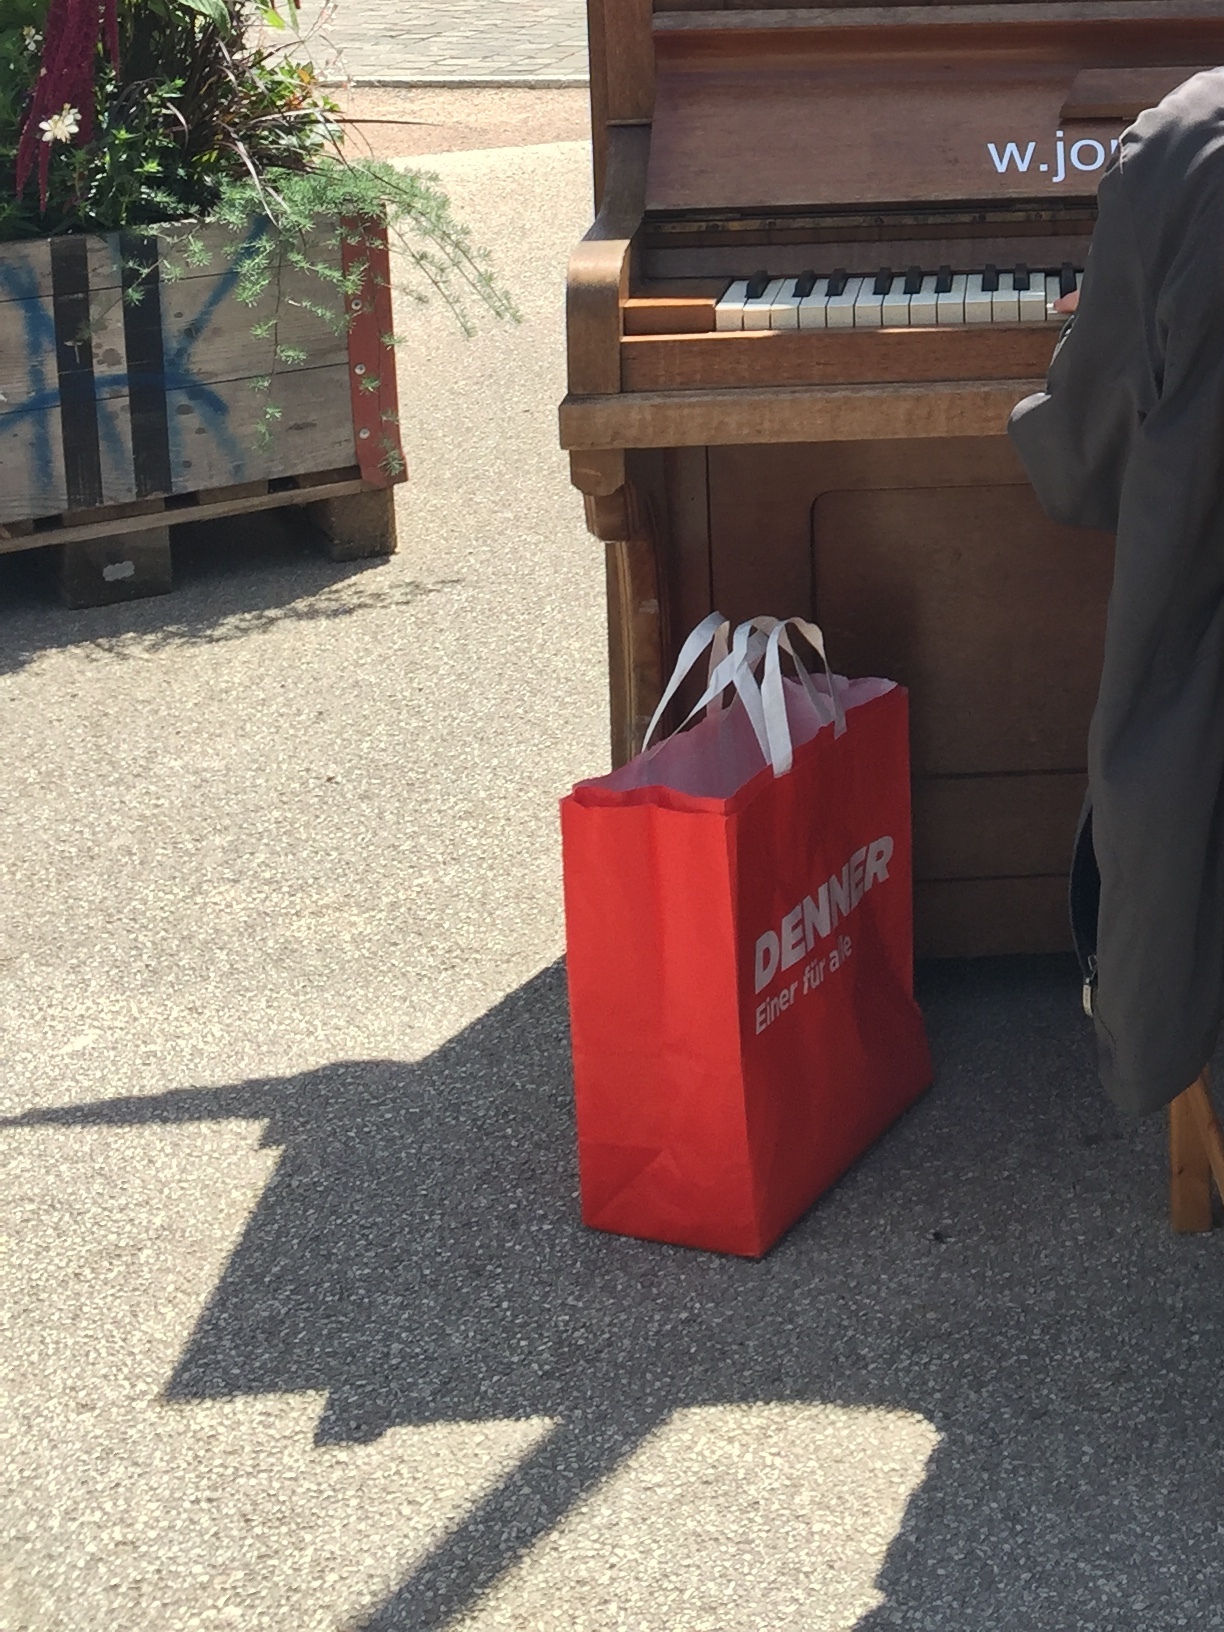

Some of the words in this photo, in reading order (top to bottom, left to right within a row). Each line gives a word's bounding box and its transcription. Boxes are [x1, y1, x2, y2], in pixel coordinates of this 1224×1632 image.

[755, 836, 894, 994] DENNER
[756, 981, 798, 1035] Einer
[803, 959, 826, 995] für
[829, 934, 852, 973] alle
